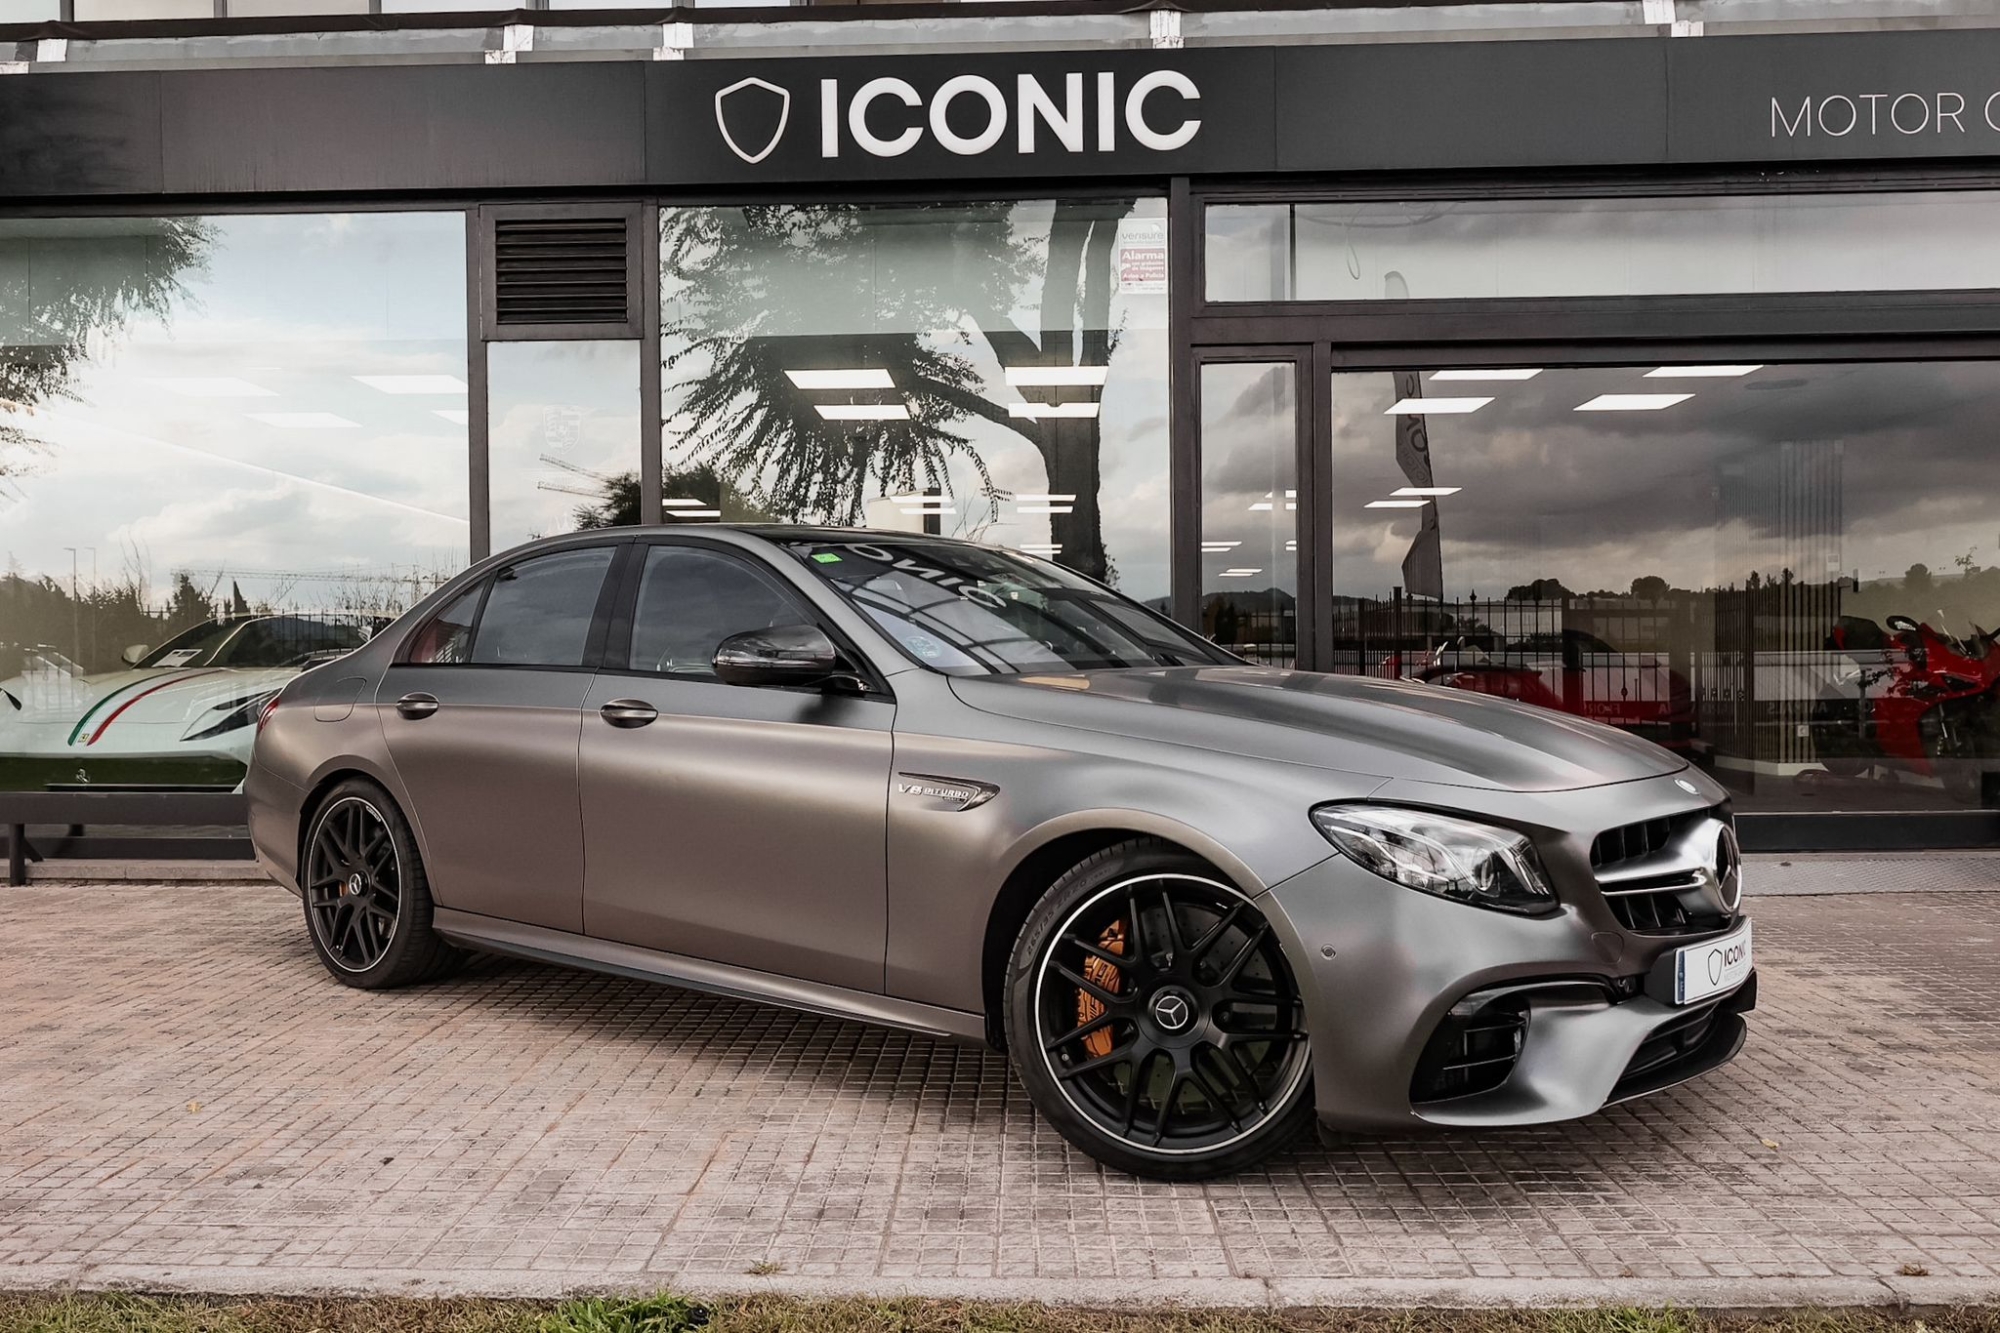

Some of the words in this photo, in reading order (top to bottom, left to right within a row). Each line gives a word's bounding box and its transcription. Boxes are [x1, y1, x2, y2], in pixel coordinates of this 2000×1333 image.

[821, 70, 1202, 158] ICONIC
[1771, 92, 1966, 137] MOTOR
[1122, 250, 1164, 260] Alarma
[898, 783, 923, 796] V8
